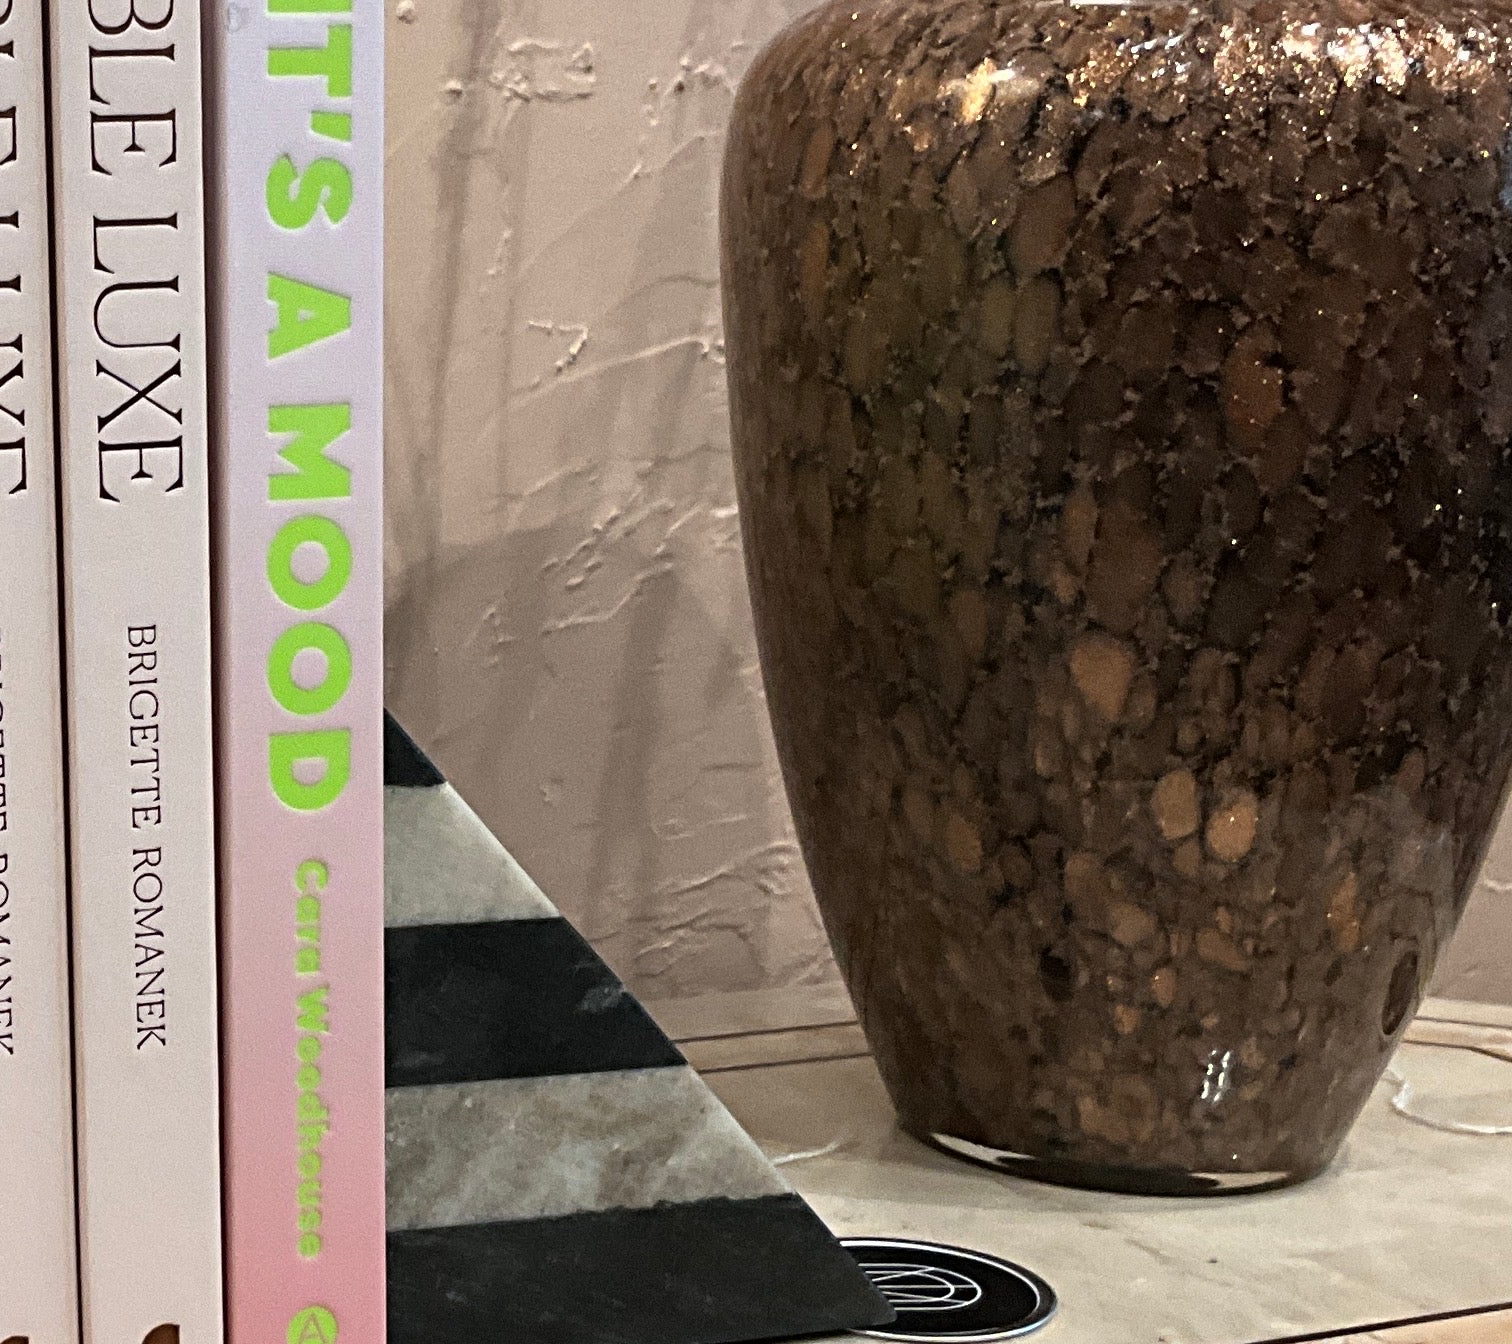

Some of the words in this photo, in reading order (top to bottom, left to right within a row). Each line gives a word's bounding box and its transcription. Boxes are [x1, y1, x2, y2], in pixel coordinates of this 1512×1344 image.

[93, 212, 183, 503] LUXE
[267, 270, 353, 361] A
[266, 401, 354, 813] MOOD
[127, 623, 162, 830] BRIGETTE
[132, 846, 167, 1051] ROMANEK
[295, 858, 329, 976] Cara
[295, 984, 331, 1261] Woodhouse
